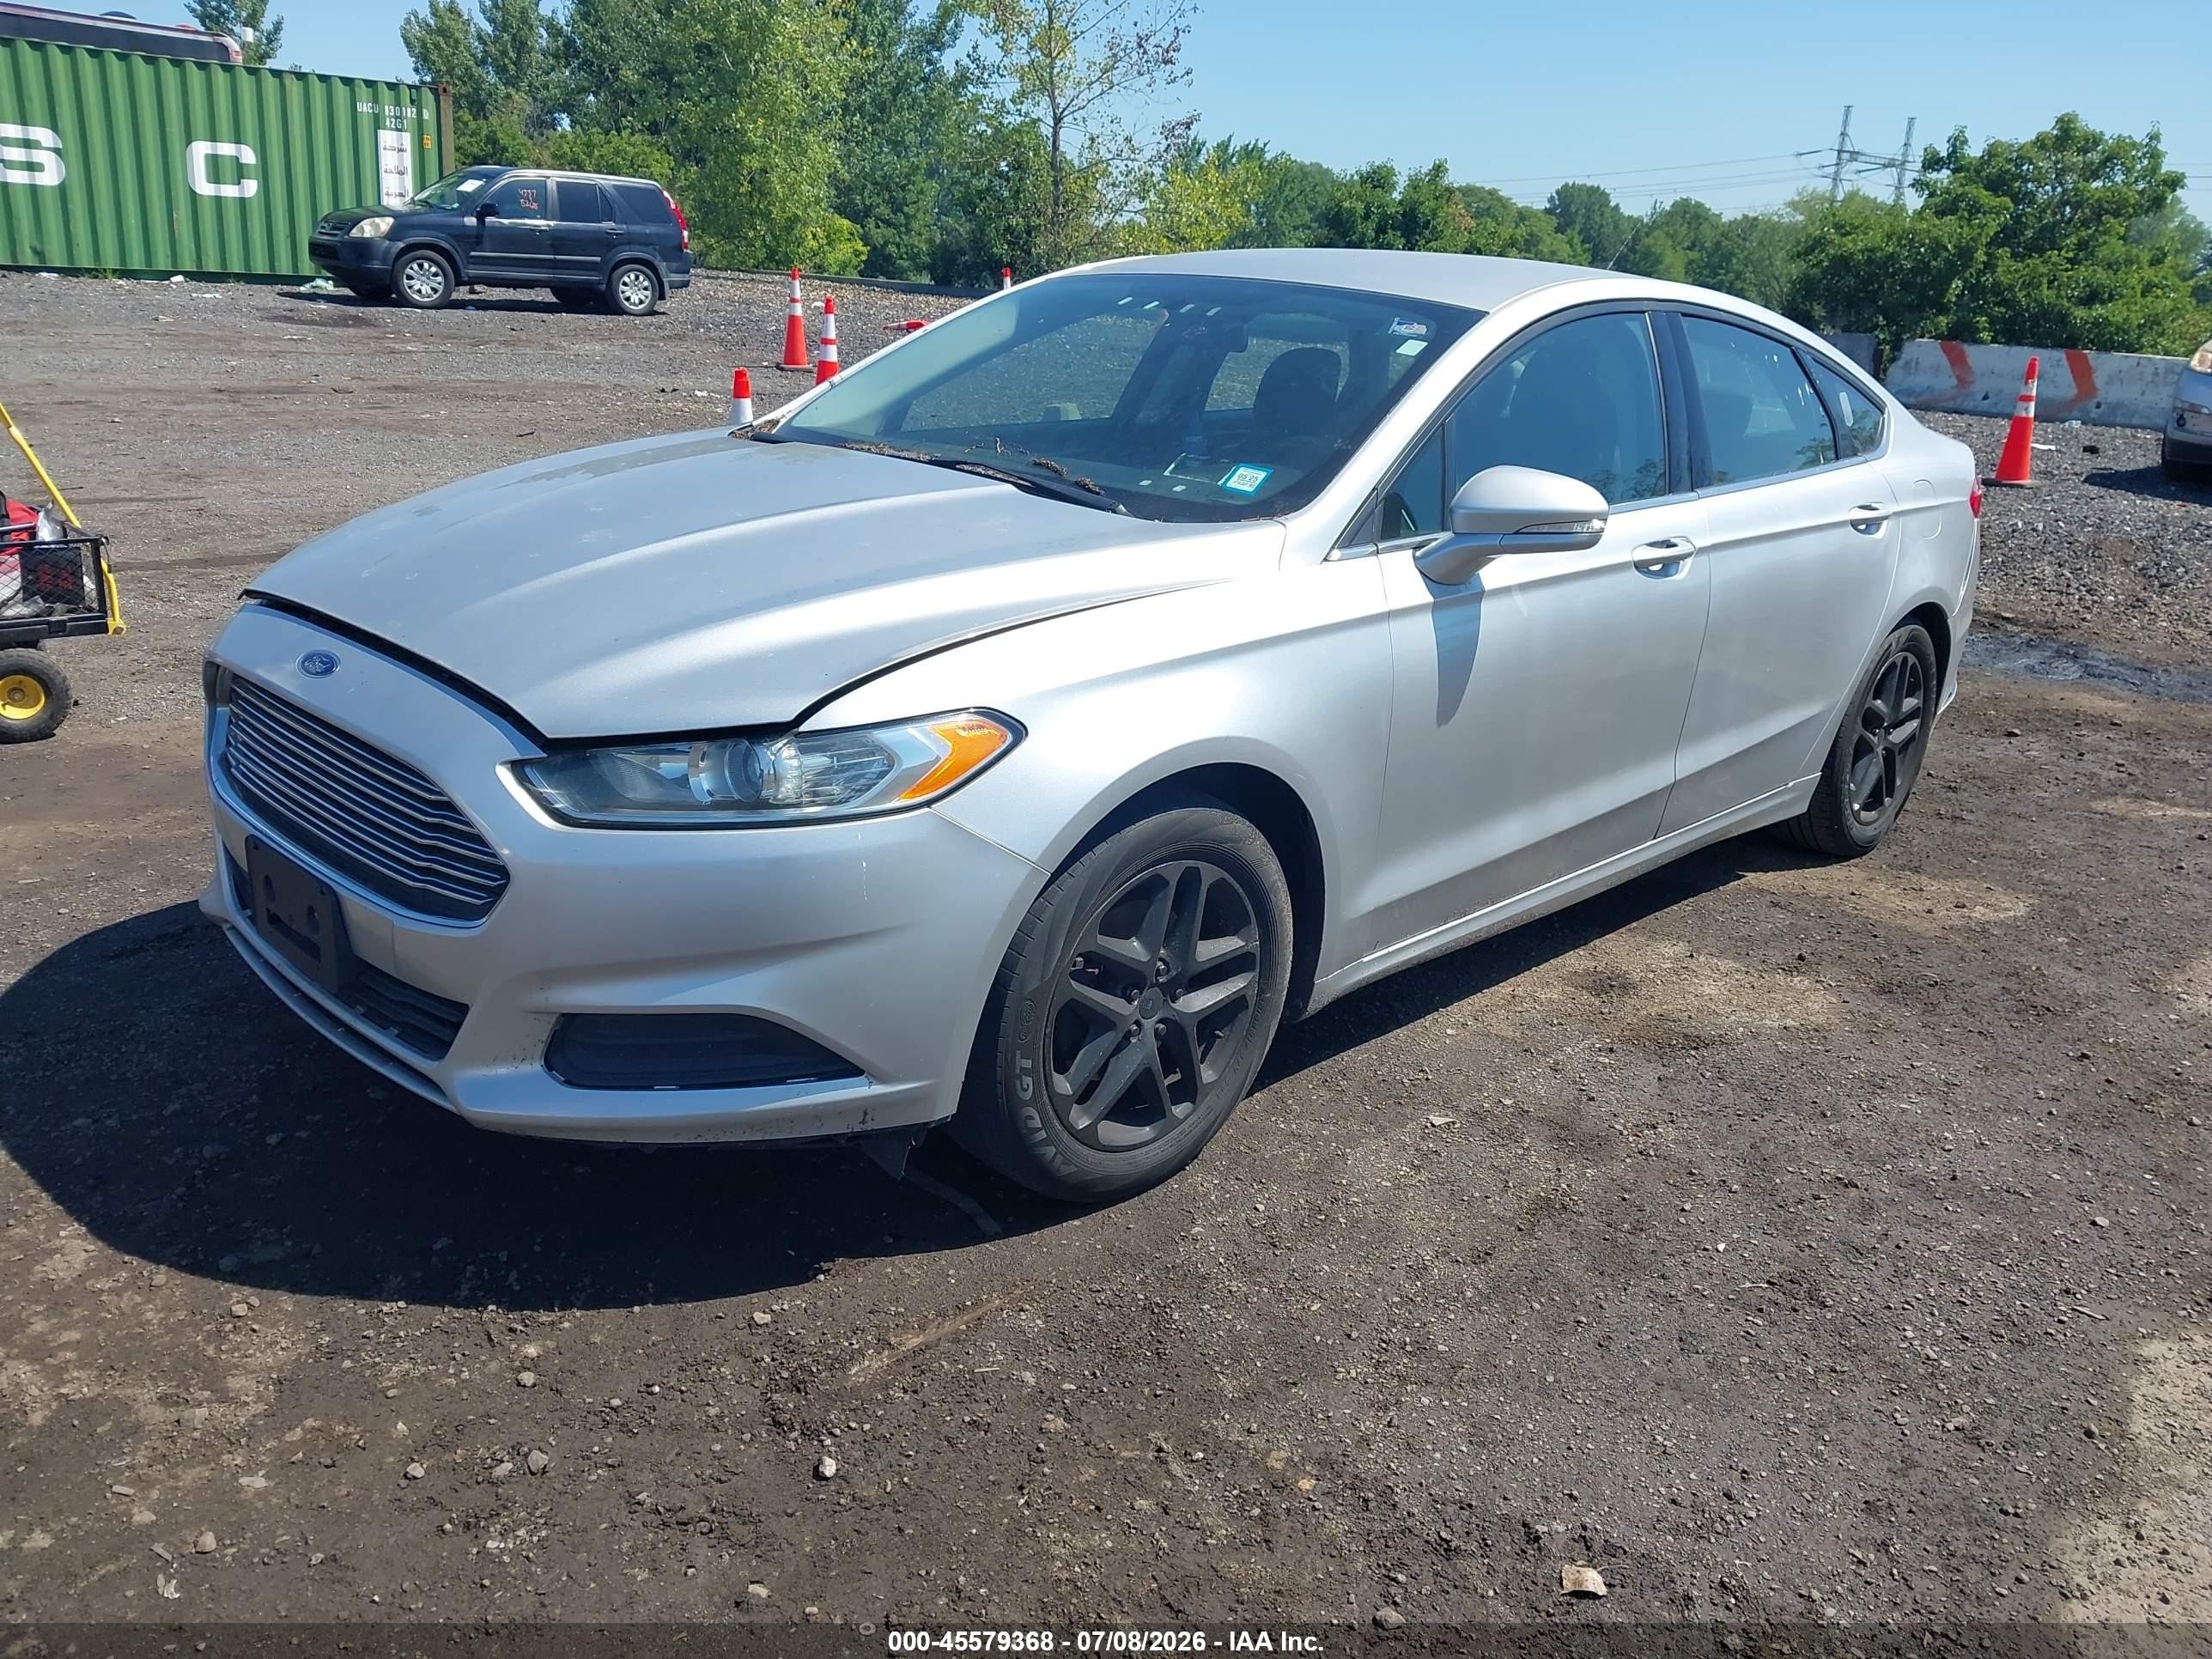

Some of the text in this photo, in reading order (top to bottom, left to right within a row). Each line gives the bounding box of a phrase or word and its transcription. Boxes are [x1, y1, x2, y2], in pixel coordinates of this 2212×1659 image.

[357, 101, 379, 113] UACU
[385, 105, 416, 118] 830182
[385, 118, 407, 130] 42G1
